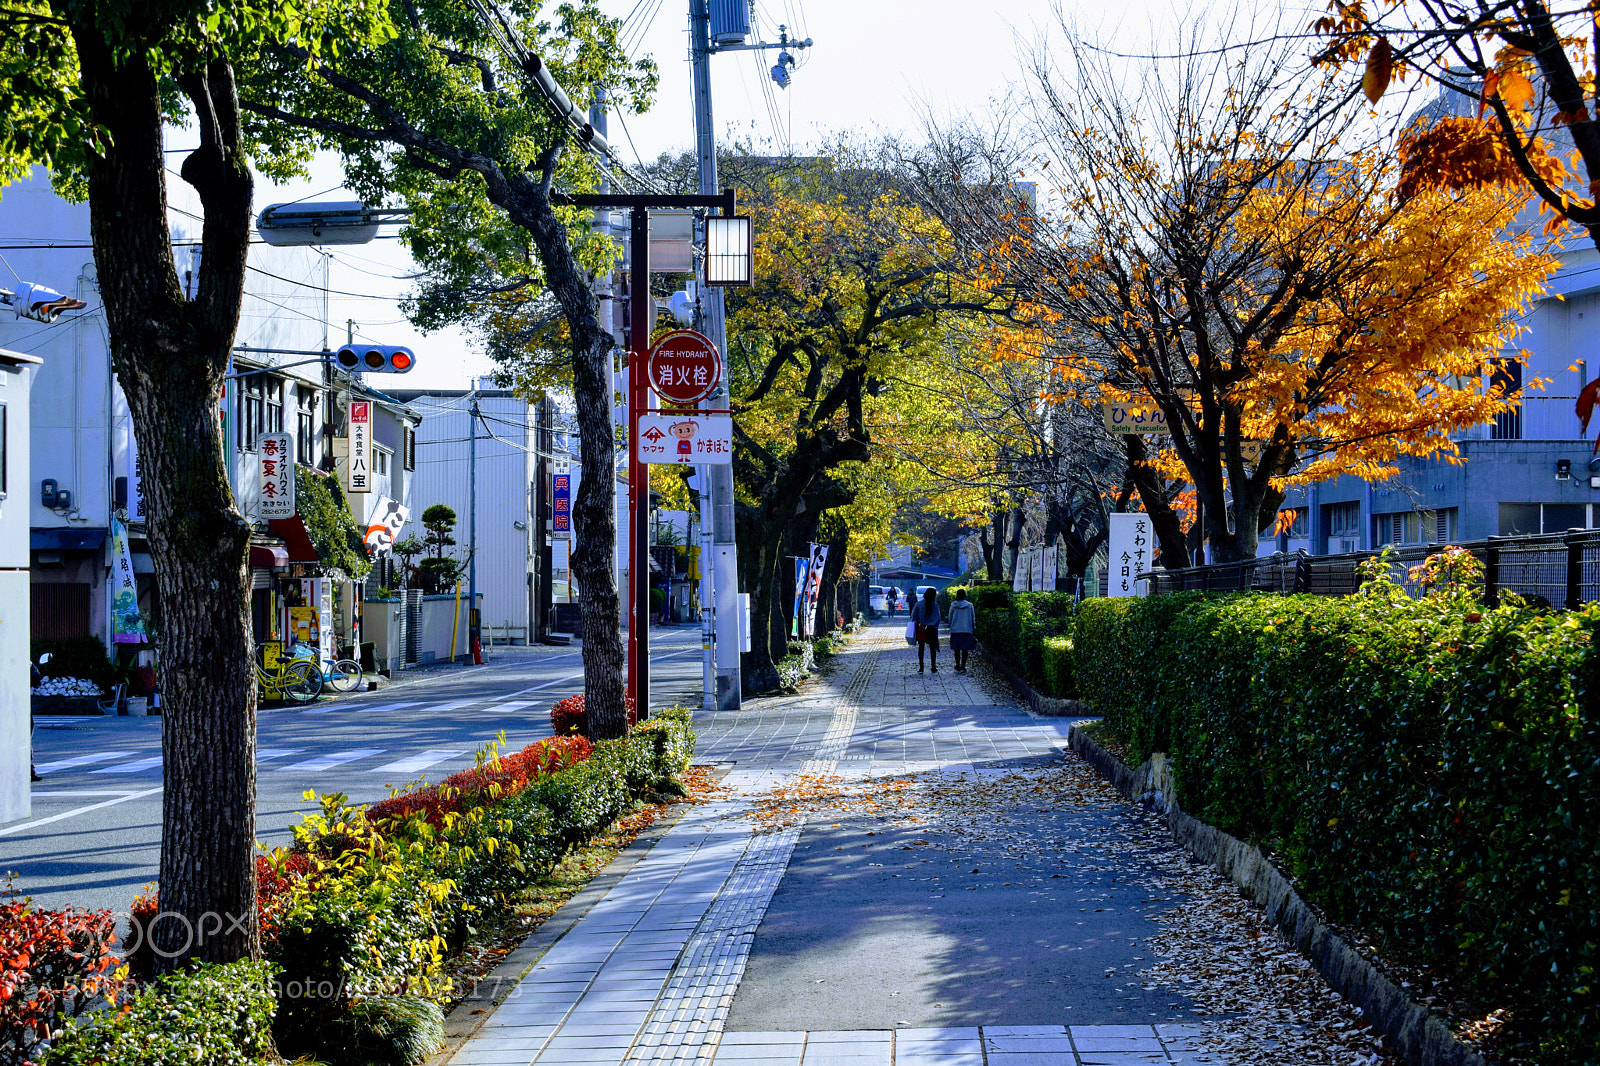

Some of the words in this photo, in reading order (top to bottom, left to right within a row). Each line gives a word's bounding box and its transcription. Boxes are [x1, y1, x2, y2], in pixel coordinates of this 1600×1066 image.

[659, 350, 675, 358] FIRE
[676, 350, 709, 359] HYDRANT
[658, 364, 708, 386] 消火栓
[355, 425, 364, 457] 大衆食堂
[642, 445, 665, 454] ヤマサ
[696, 438, 730, 454] かまぼこ
[261, 439, 280, 499] 春夏冬
[279, 438, 288, 497] カラオケハウス
[353, 458, 366, 488] 八宝
[262, 500, 290, 508] あきない
[554, 477, 569, 530] 兵医院
[1120, 551, 1132, 592] 今日も
